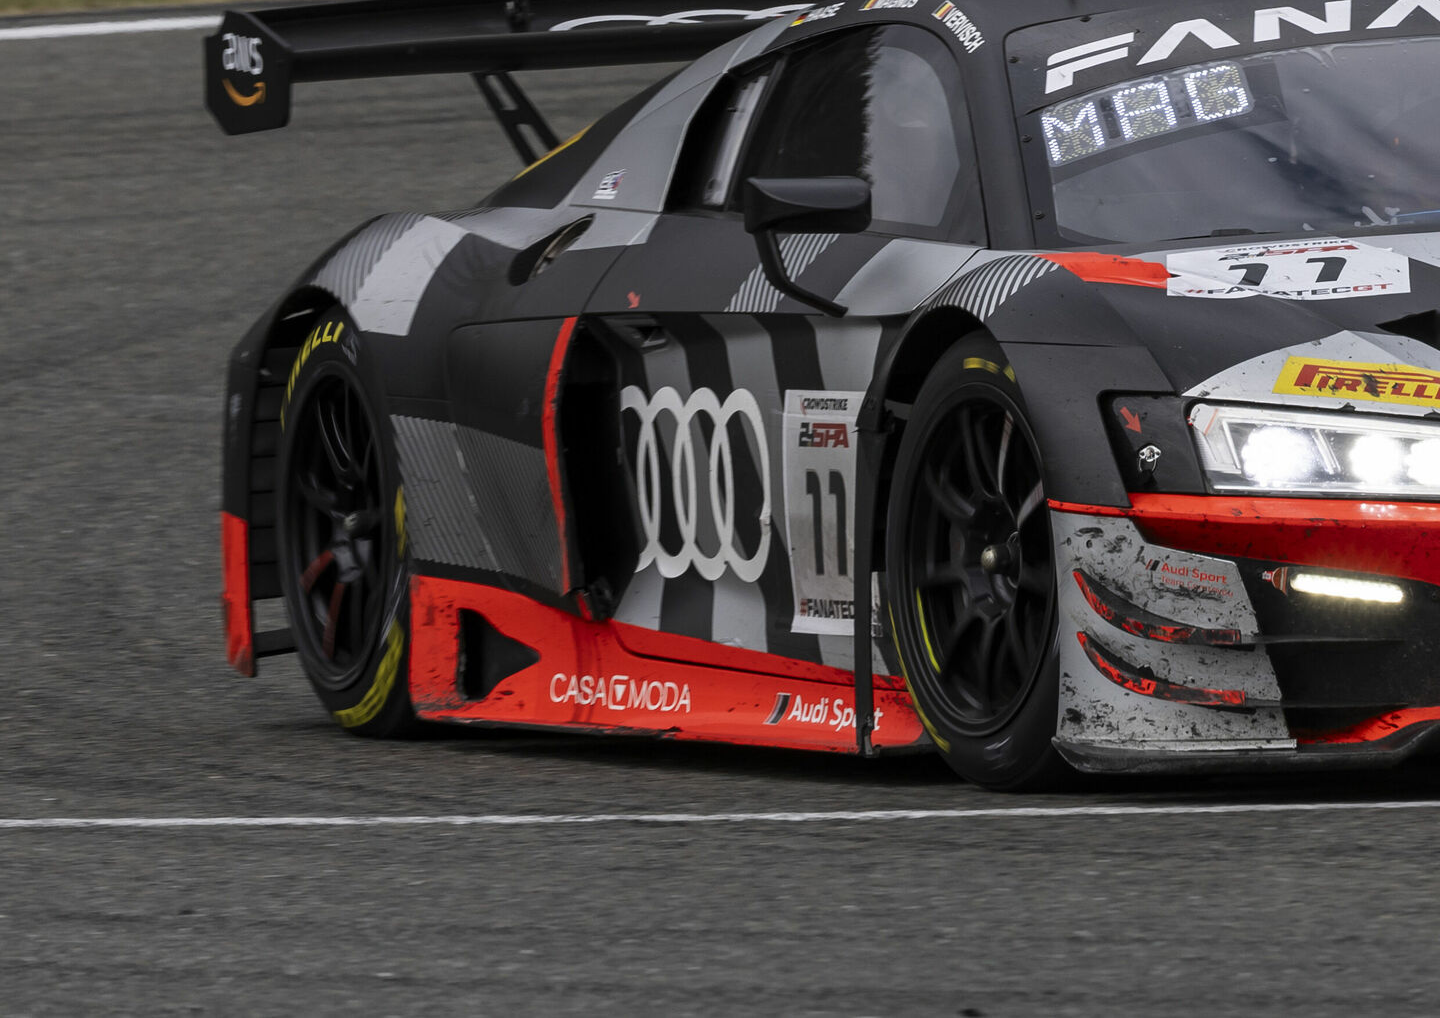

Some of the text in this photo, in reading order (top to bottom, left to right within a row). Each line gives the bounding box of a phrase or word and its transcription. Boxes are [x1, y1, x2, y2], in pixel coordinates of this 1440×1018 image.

[942, 8, 985, 53] VERVISCH
[222, 32, 264, 75] aws
[1041, 65, 1249, 163] MAG
[1227, 256, 1347, 286] 11
[806, 468, 849, 576] 11
[1161, 562, 1228, 584] Audi Sport
[788, 695, 884, 732] Audi Spt
